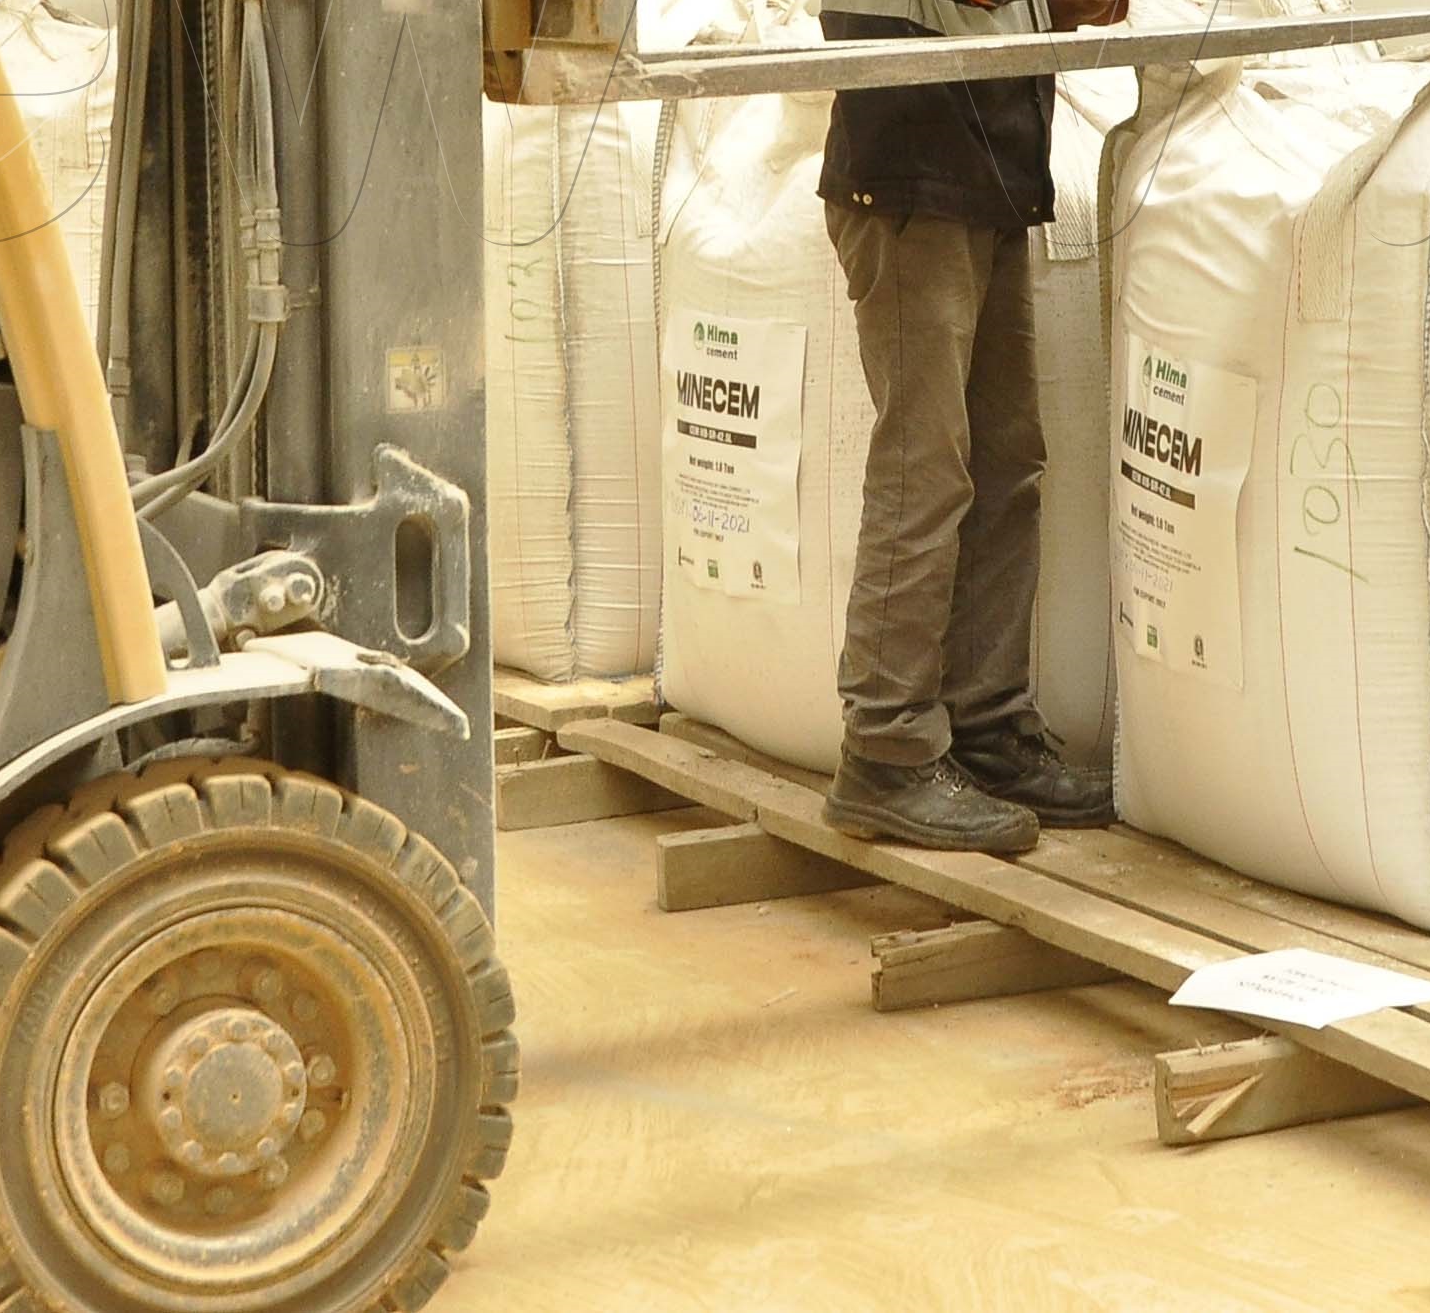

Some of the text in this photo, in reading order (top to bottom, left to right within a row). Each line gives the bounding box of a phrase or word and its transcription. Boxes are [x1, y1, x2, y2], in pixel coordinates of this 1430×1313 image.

[706, 324, 739, 345] Hima
[706, 347, 739, 361] cement
[1155, 358, 1188, 388] Hima
[677, 369, 761, 421] MINECEM
[1153, 385, 1186, 407] cement
[1122, 403, 1203, 477] MINECEM
